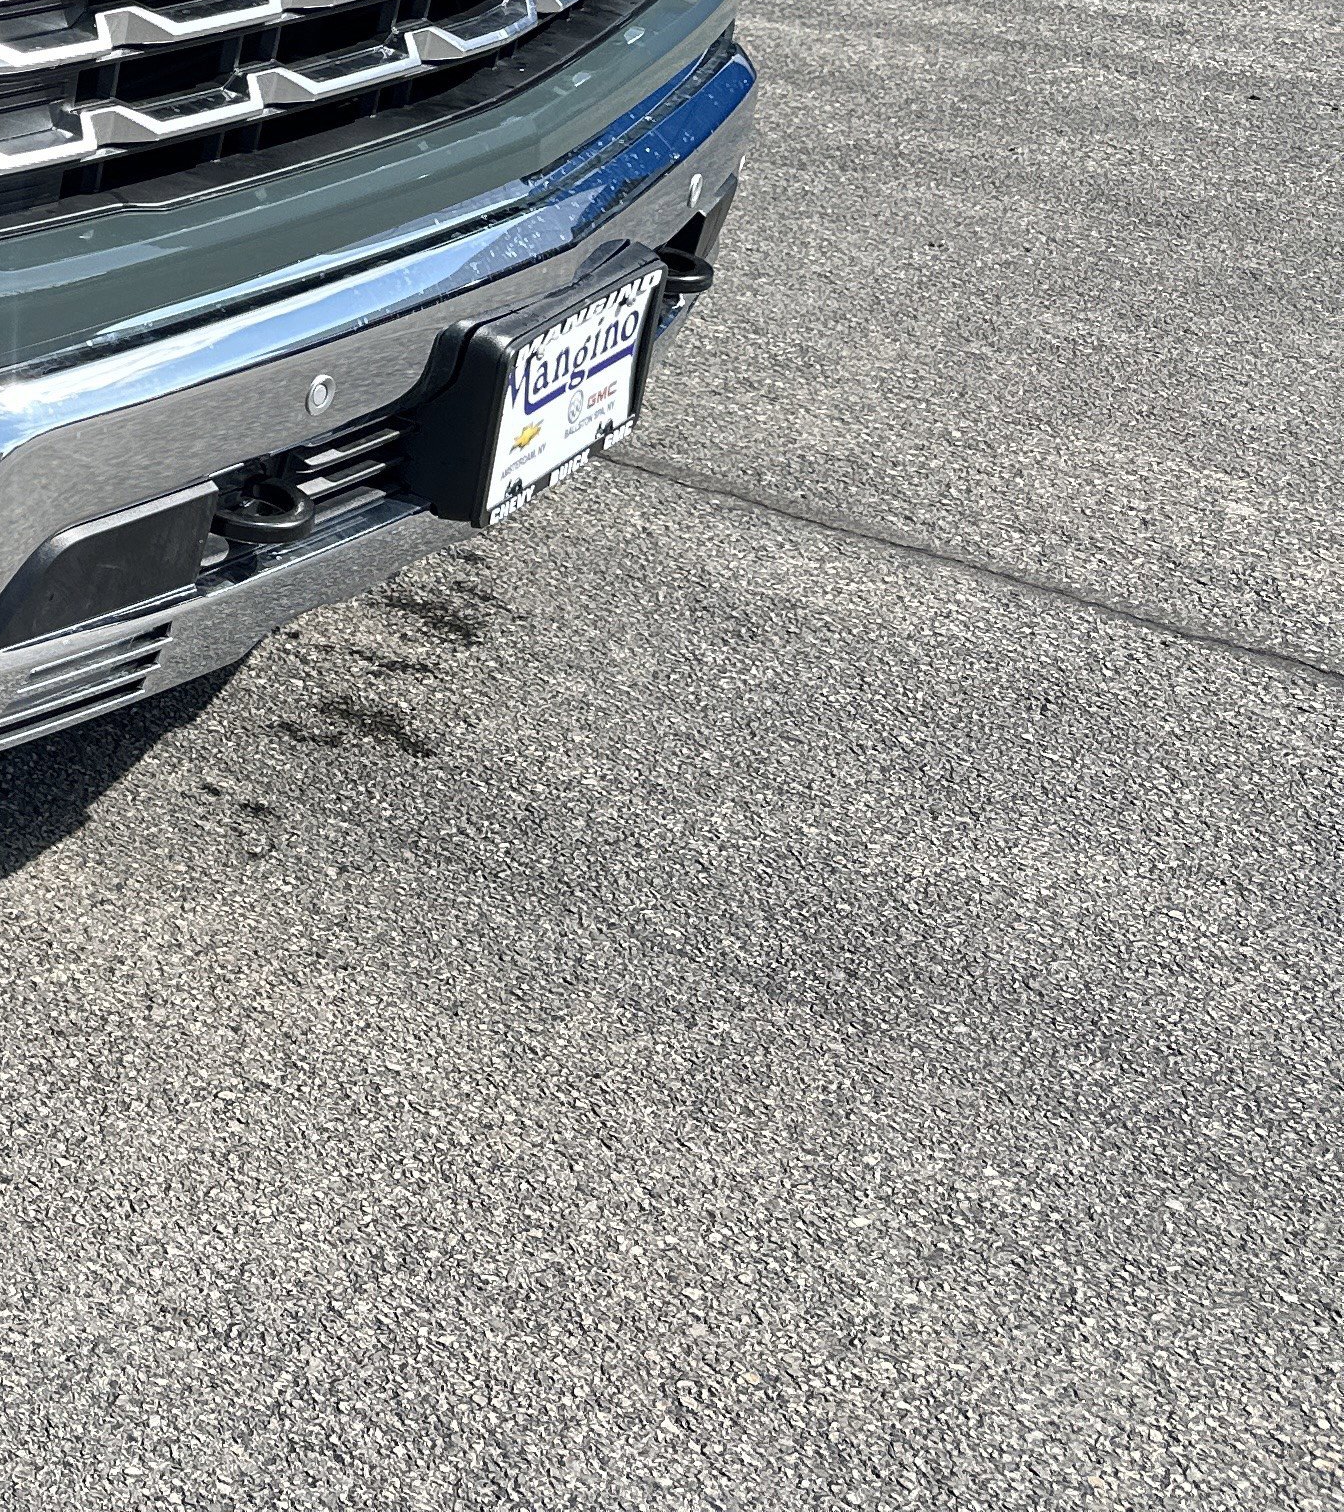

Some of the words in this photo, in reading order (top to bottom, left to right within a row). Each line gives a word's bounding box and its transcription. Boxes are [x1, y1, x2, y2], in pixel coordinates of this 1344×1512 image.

[507, 310, 640, 415] Mangino
[587, 380, 618, 410] GMC
[489, 485, 536, 525] CHEVY
[549, 448, 591, 488] BUICK
[603, 420, 634, 450] GMC
